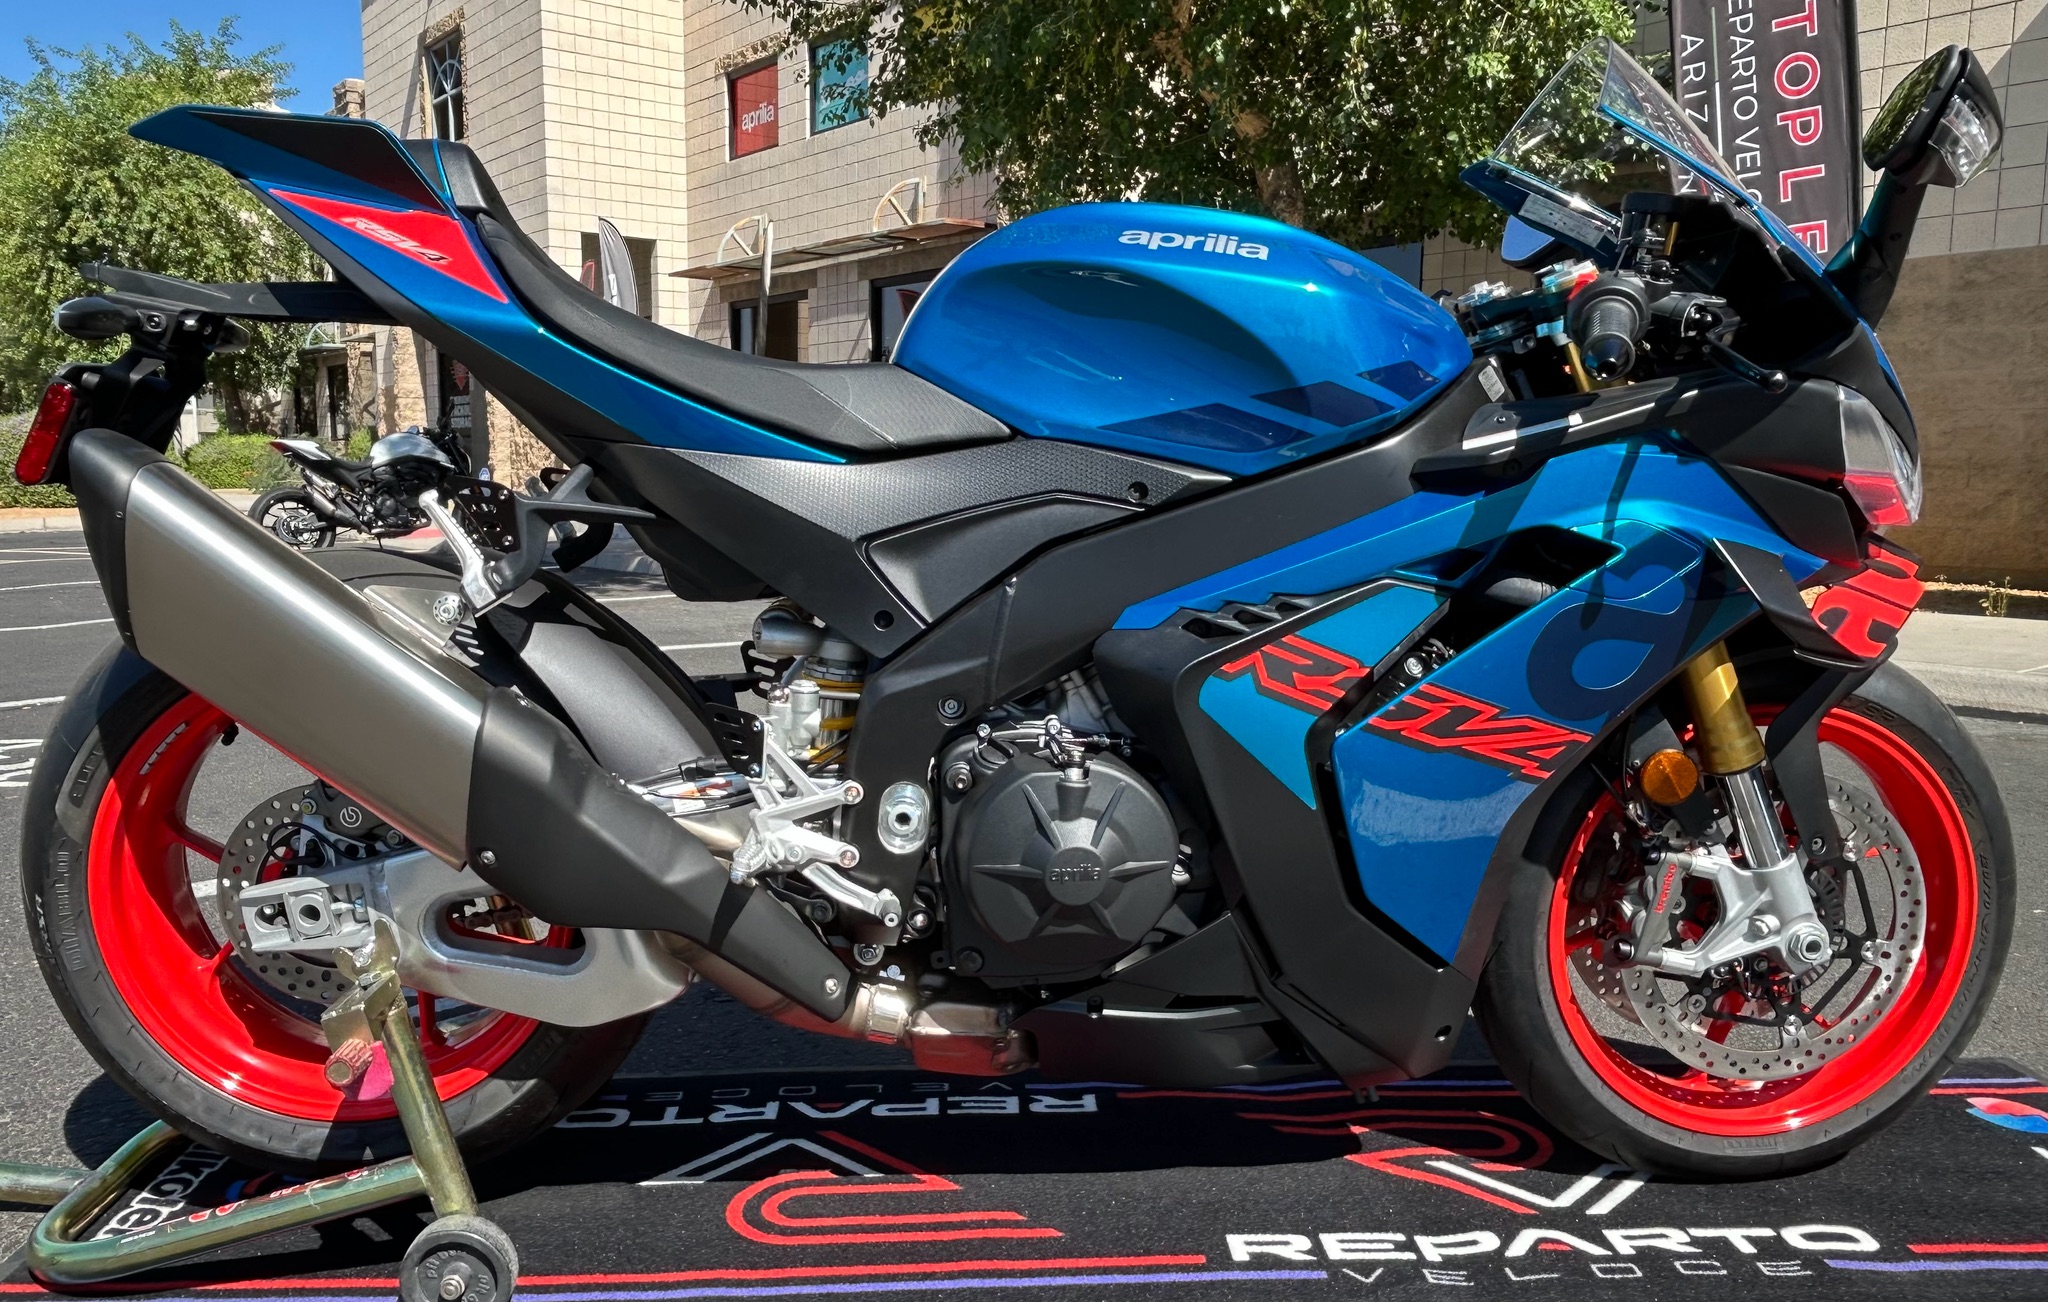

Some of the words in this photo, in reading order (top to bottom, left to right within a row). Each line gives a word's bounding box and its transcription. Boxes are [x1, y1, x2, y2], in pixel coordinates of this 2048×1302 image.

[741, 103, 774, 133] aprilia
[1118, 229, 1270, 261] aprilia
[1051, 863, 1101, 884] aprilia
[1225, 1224, 1881, 1263] REPARTO
[1342, 1259, 1813, 1287] VELOCE
